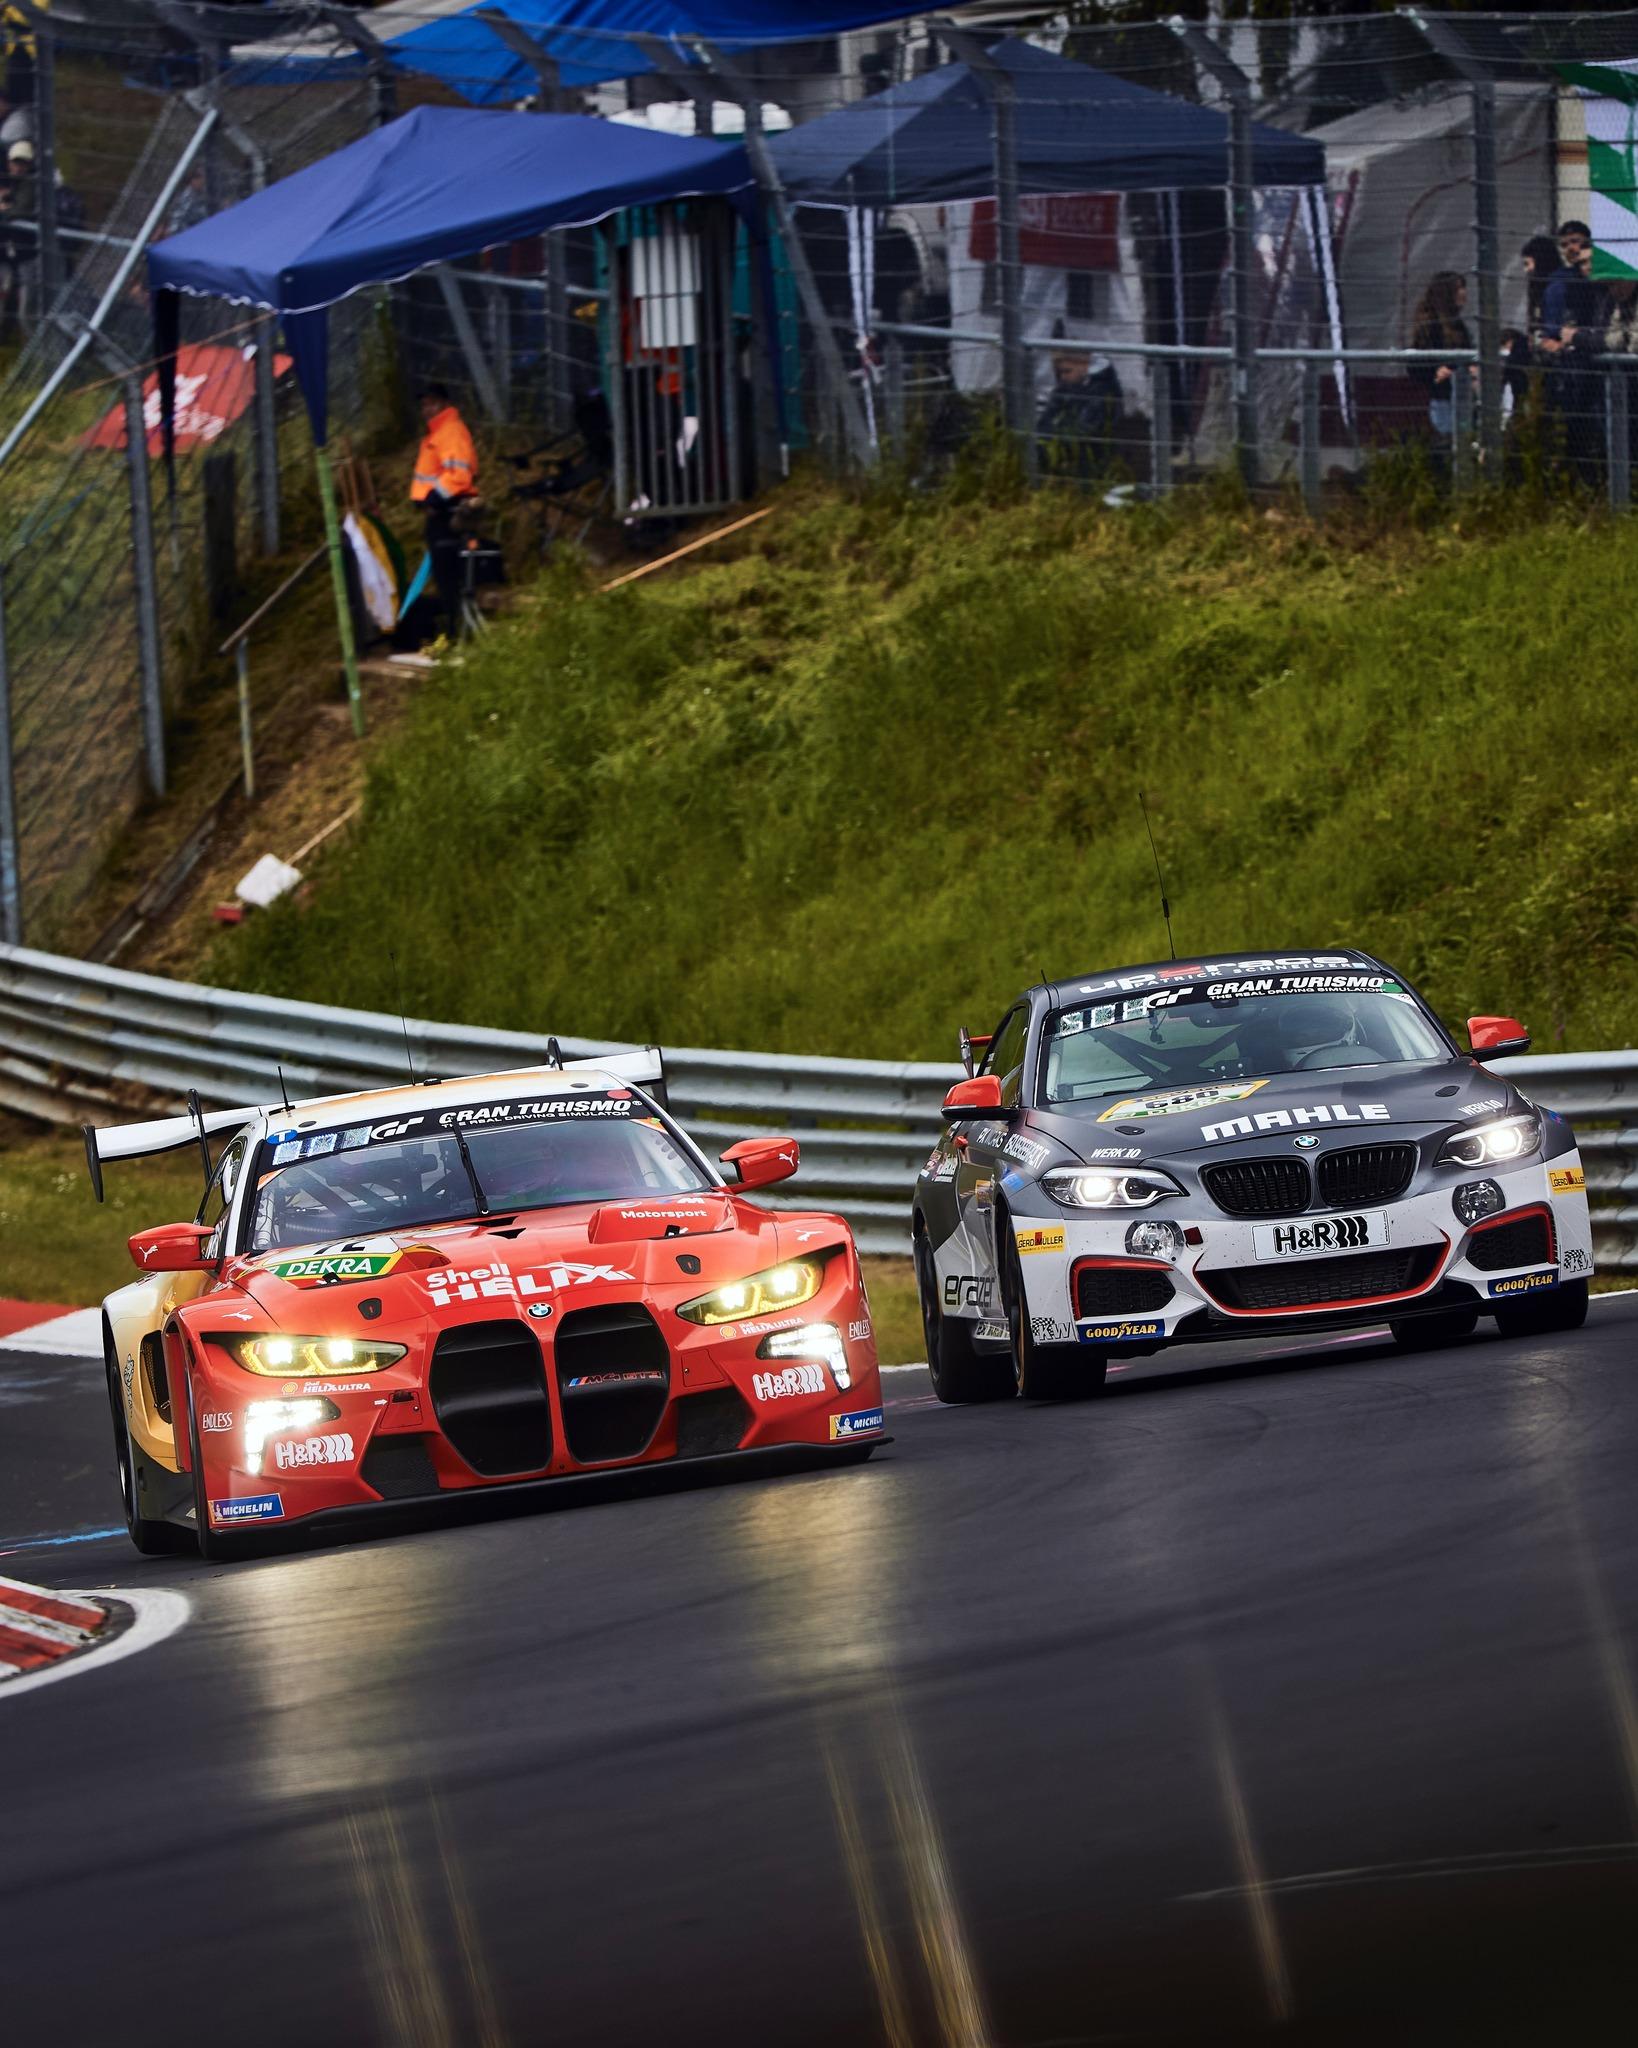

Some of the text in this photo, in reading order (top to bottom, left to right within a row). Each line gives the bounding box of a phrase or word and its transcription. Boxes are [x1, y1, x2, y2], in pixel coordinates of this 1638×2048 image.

[1134, 963, 1351, 988] PATRICK SCHNEIDER
[1207, 978, 1272, 996] GRAN
[1234, 990, 1266, 998] REAL
[438, 1105, 511, 1124] GRAN
[469, 1117, 502, 1125] REAL
[1200, 1103, 1391, 1142] MAHLE
[1091, 1148, 1128, 1158] WERK
[620, 1210, 708, 1219] Motorsport
[1273, 1221, 1337, 1255] H&R
[286, 1257, 373, 1277] DEKRA
[426, 1263, 511, 1288] Shell
[428, 1262, 636, 1307] HELIX
[773, 1317, 804, 1329] ULTRA
[849, 1319, 871, 1338] ENDLESS
[1086, 1323, 1157, 1339] GOODYEAR
[303, 1382, 371, 1393] HELIX ULTRA
[202, 1412, 233, 1430] ENDLESS
[222, 1502, 273, 1515] MICHELIN
